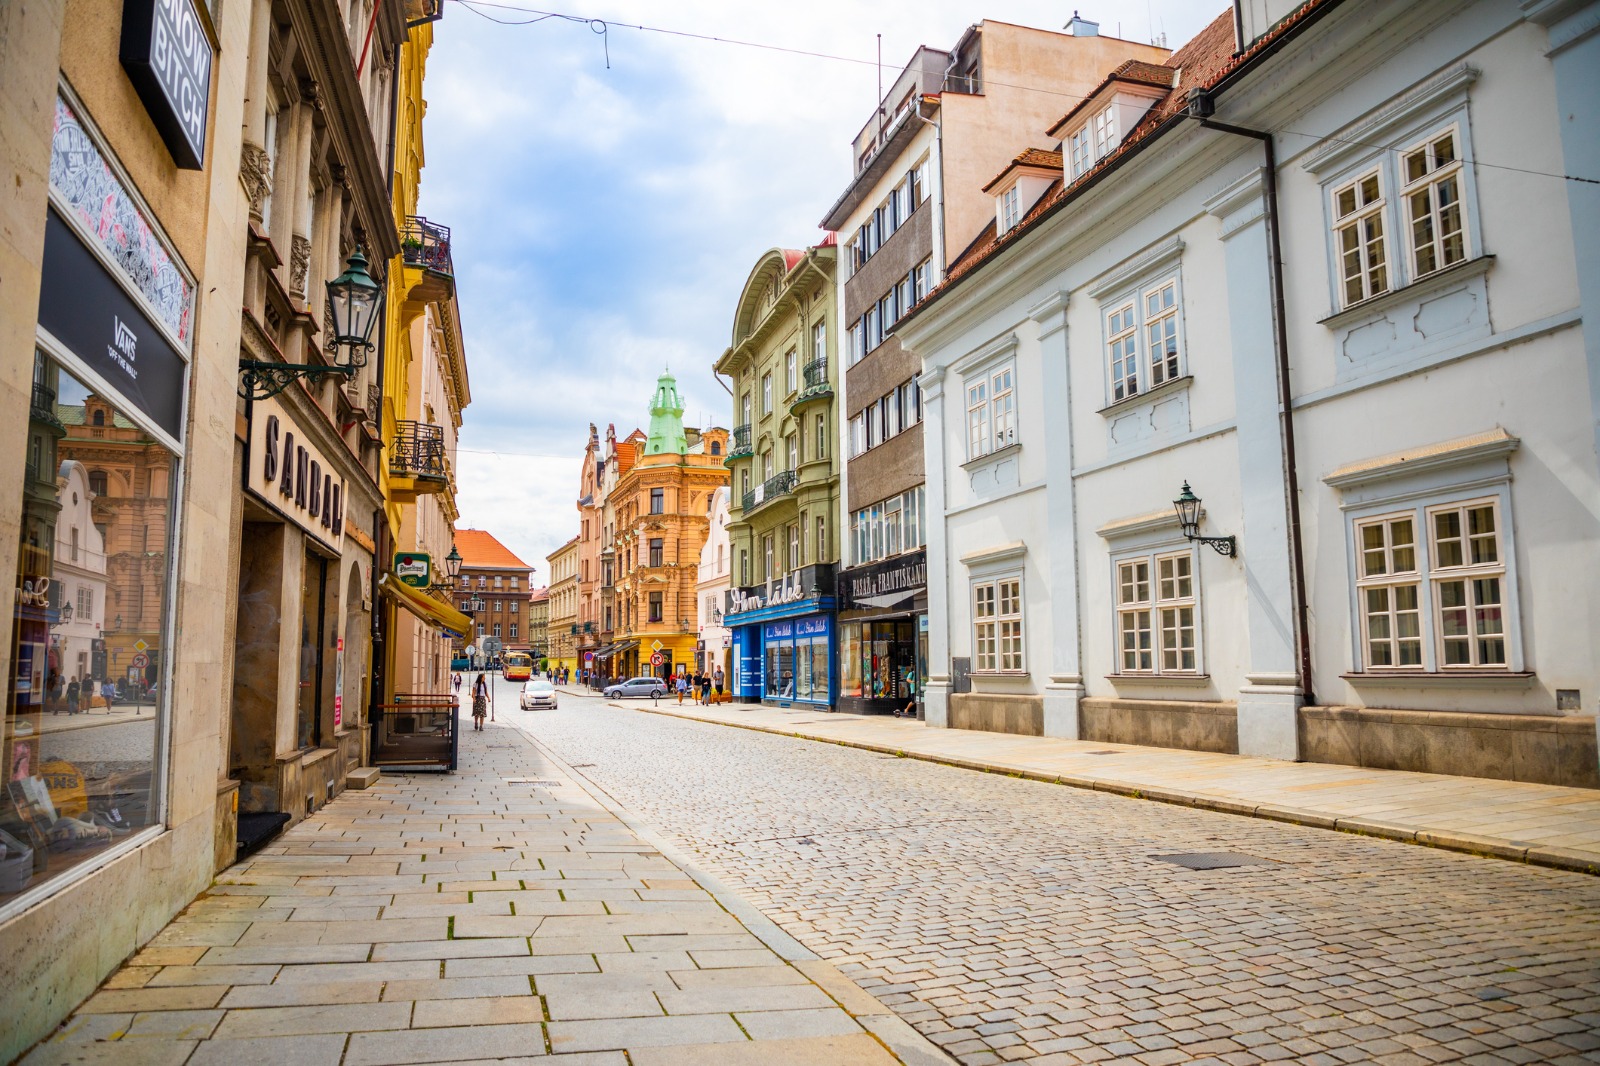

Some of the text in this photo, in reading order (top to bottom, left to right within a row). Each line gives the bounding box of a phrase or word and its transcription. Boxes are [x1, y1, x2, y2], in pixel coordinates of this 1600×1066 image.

[162, 0, 207, 87] NOW
[155, 15, 202, 147] BITCH
[114, 314, 138, 361] VANS
[118, 354, 126, 369] THE
